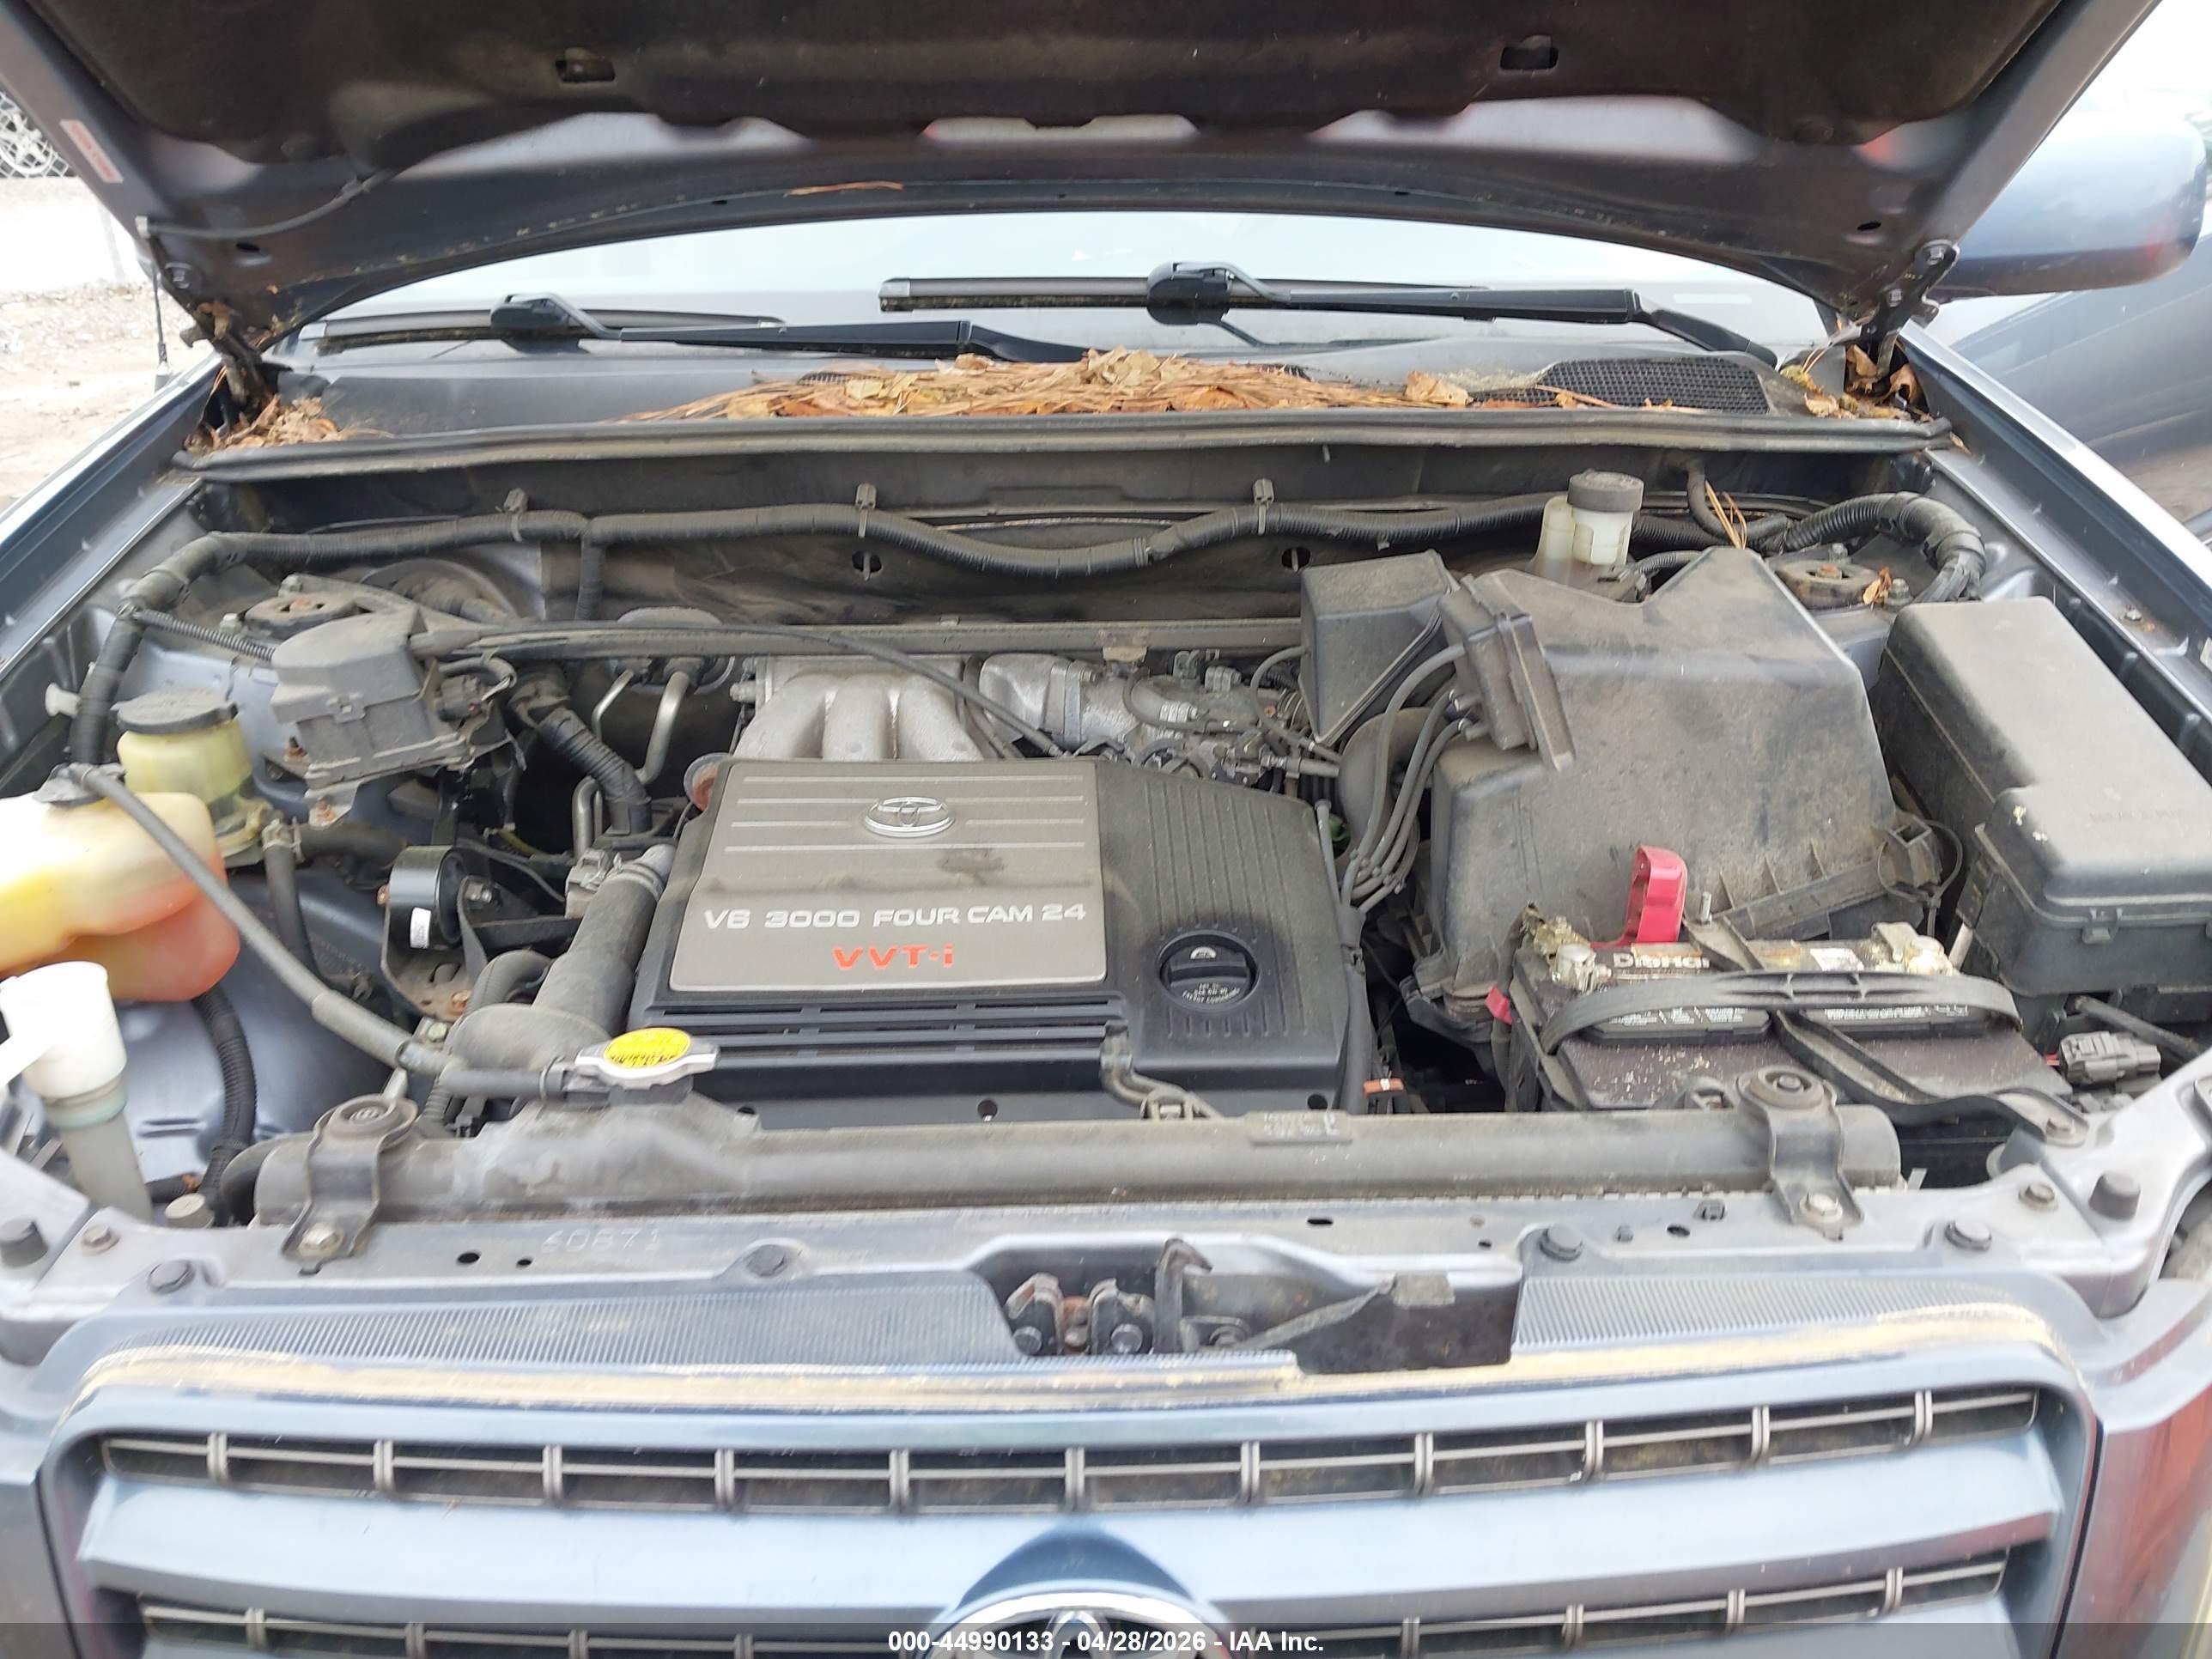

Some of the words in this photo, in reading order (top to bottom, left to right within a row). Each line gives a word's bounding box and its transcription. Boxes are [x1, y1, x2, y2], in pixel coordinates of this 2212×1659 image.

[703, 908, 751, 930] V6
[763, 908, 861, 929] 3000
[872, 906, 962, 928] FOUR
[967, 903, 1034, 925] CAM
[1041, 902, 1087, 922] 24
[833, 945, 954, 969] VVT-i
